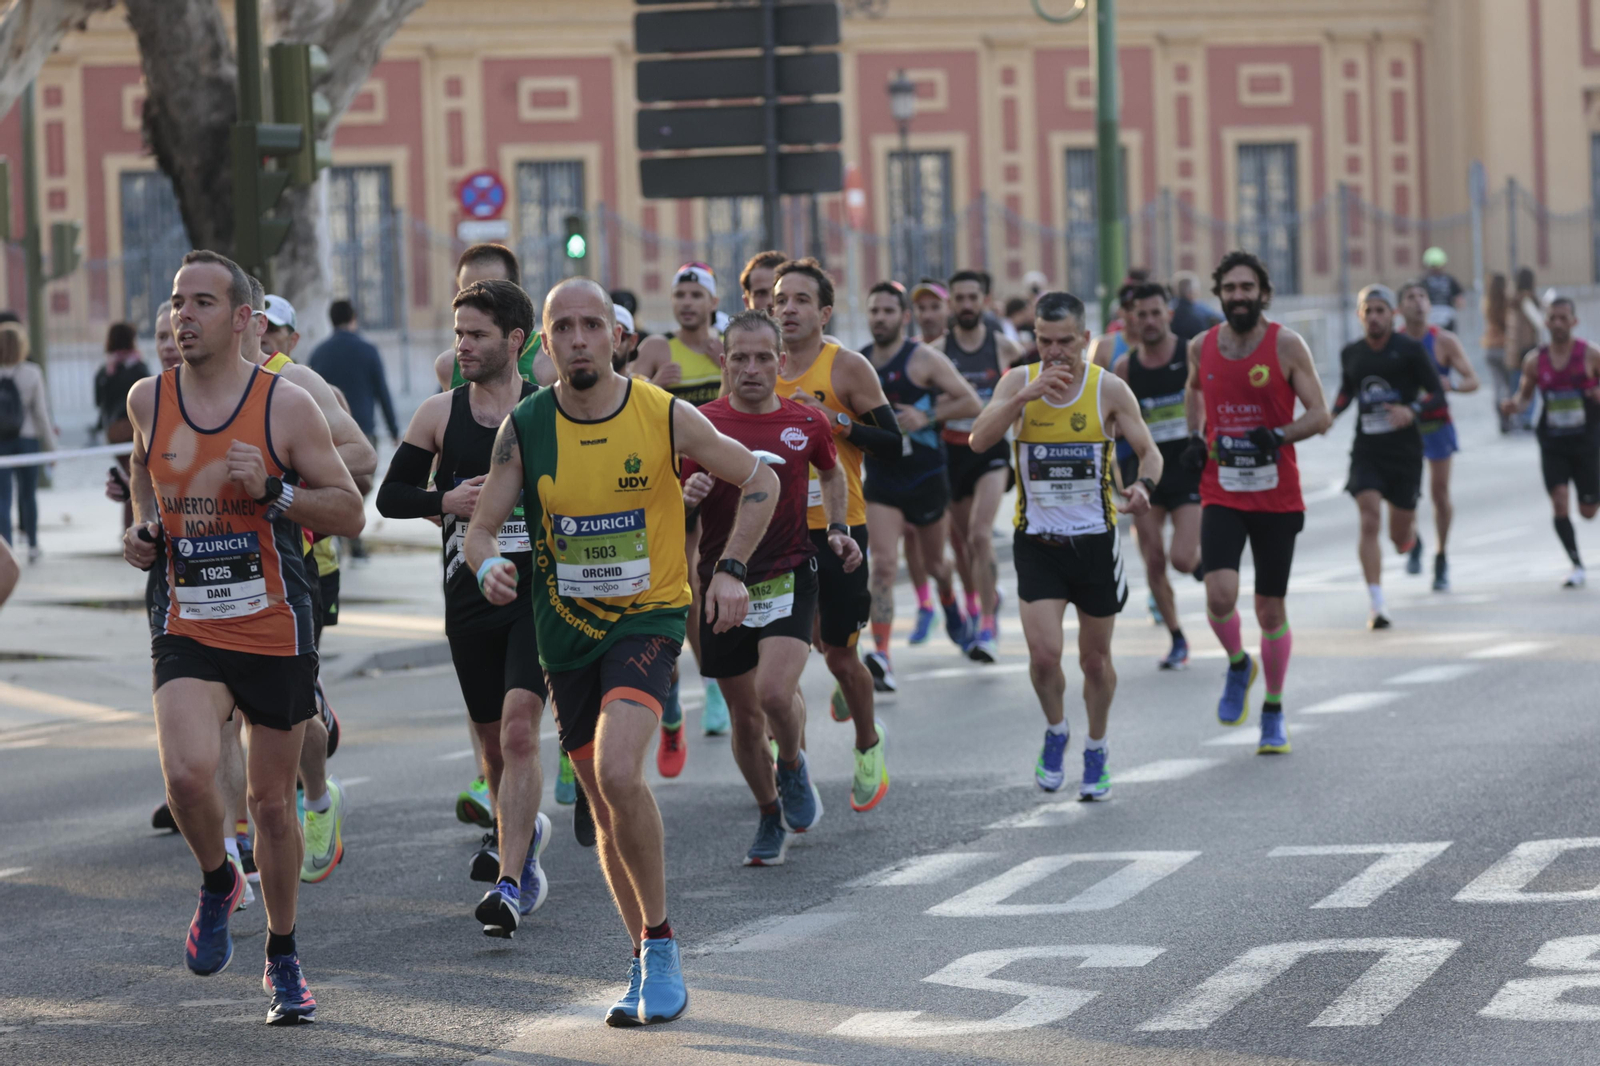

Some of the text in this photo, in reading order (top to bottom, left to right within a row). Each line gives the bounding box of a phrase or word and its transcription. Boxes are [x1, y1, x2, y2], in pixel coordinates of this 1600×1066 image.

[1048, 447, 1088, 458] ZURICH
[1048, 467, 1073, 477] 2852
[618, 475, 649, 489] UDV
[185, 516, 234, 538] MOAÑA
[580, 515, 635, 532] ZURICH
[196, 537, 249, 554] ZURICH
[584, 545, 617, 560] 1503
[200, 565, 232, 581] 1925
[582, 566, 623, 579] ORCHID
[206, 587, 232, 599] DANI
